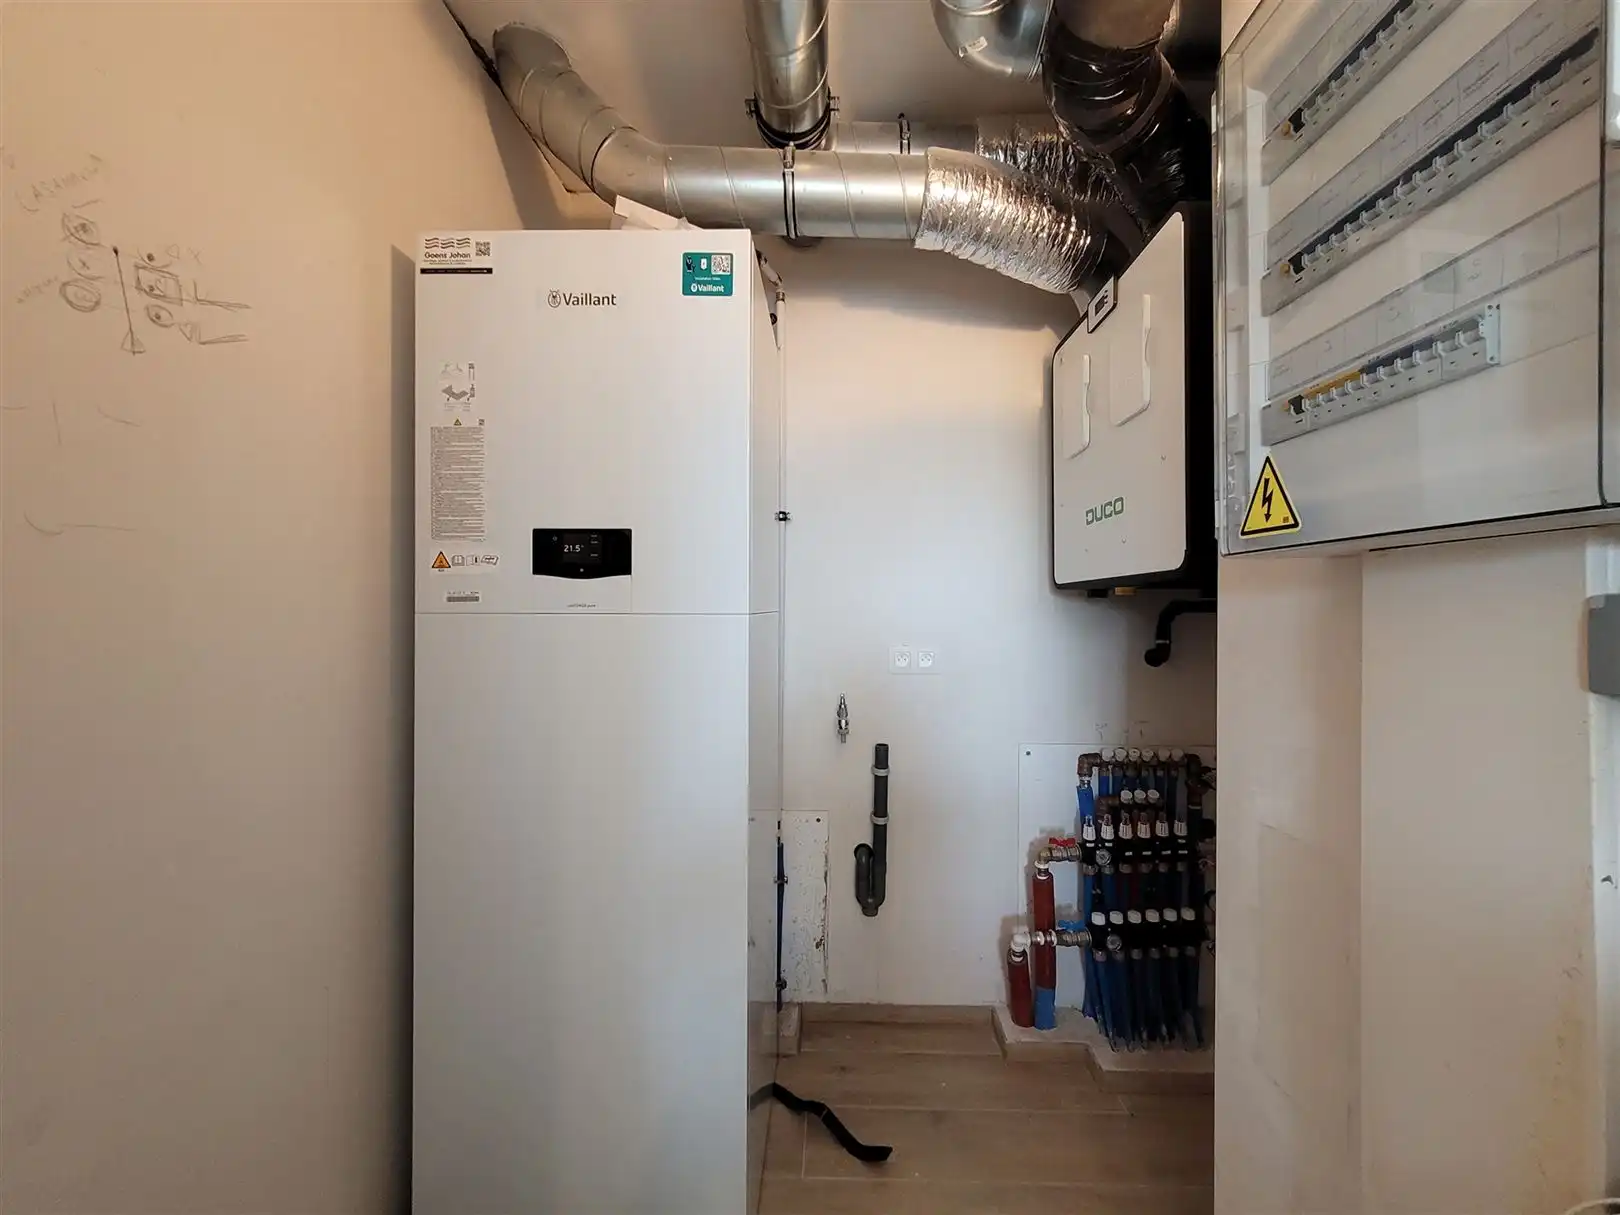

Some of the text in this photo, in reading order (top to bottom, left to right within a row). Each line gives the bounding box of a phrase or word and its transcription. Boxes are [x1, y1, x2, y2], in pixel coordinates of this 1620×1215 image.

[449, 251, 471, 259] Johan
[697, 283, 725, 293] Vaillant
[562, 292, 617, 306] Vaillant
[1085, 496, 1124, 526] DUCO
